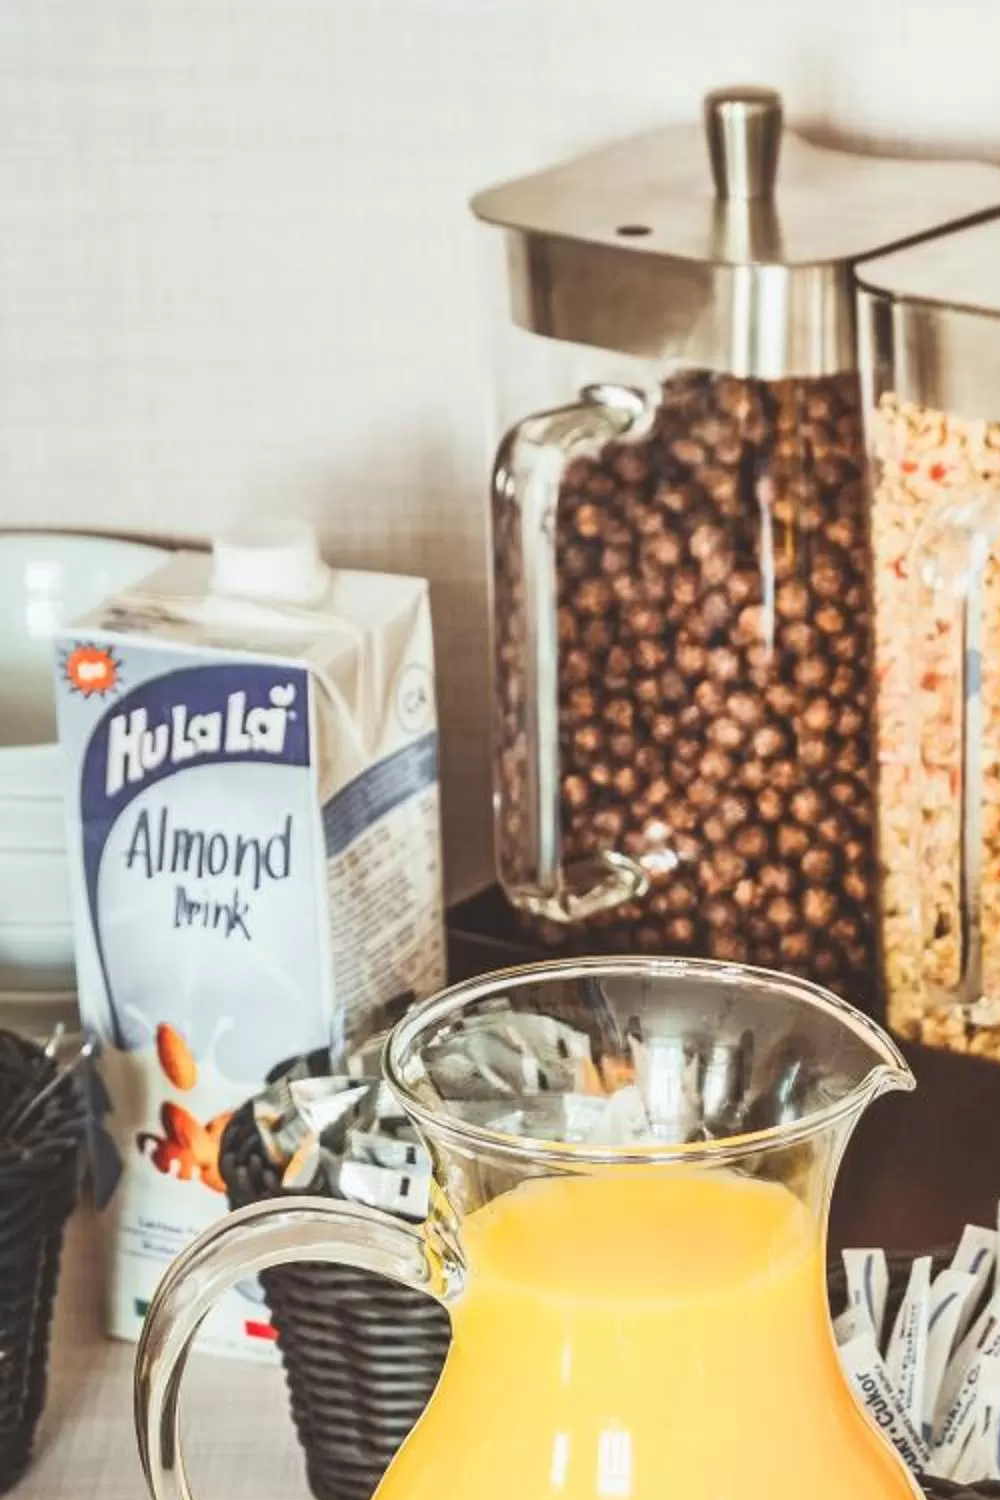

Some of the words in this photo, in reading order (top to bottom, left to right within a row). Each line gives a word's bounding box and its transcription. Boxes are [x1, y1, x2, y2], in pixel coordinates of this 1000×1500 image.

[125, 805, 292, 890] Almond
[174, 884, 251, 941] Drink
[856, 1372, 895, 1428] Cukor
